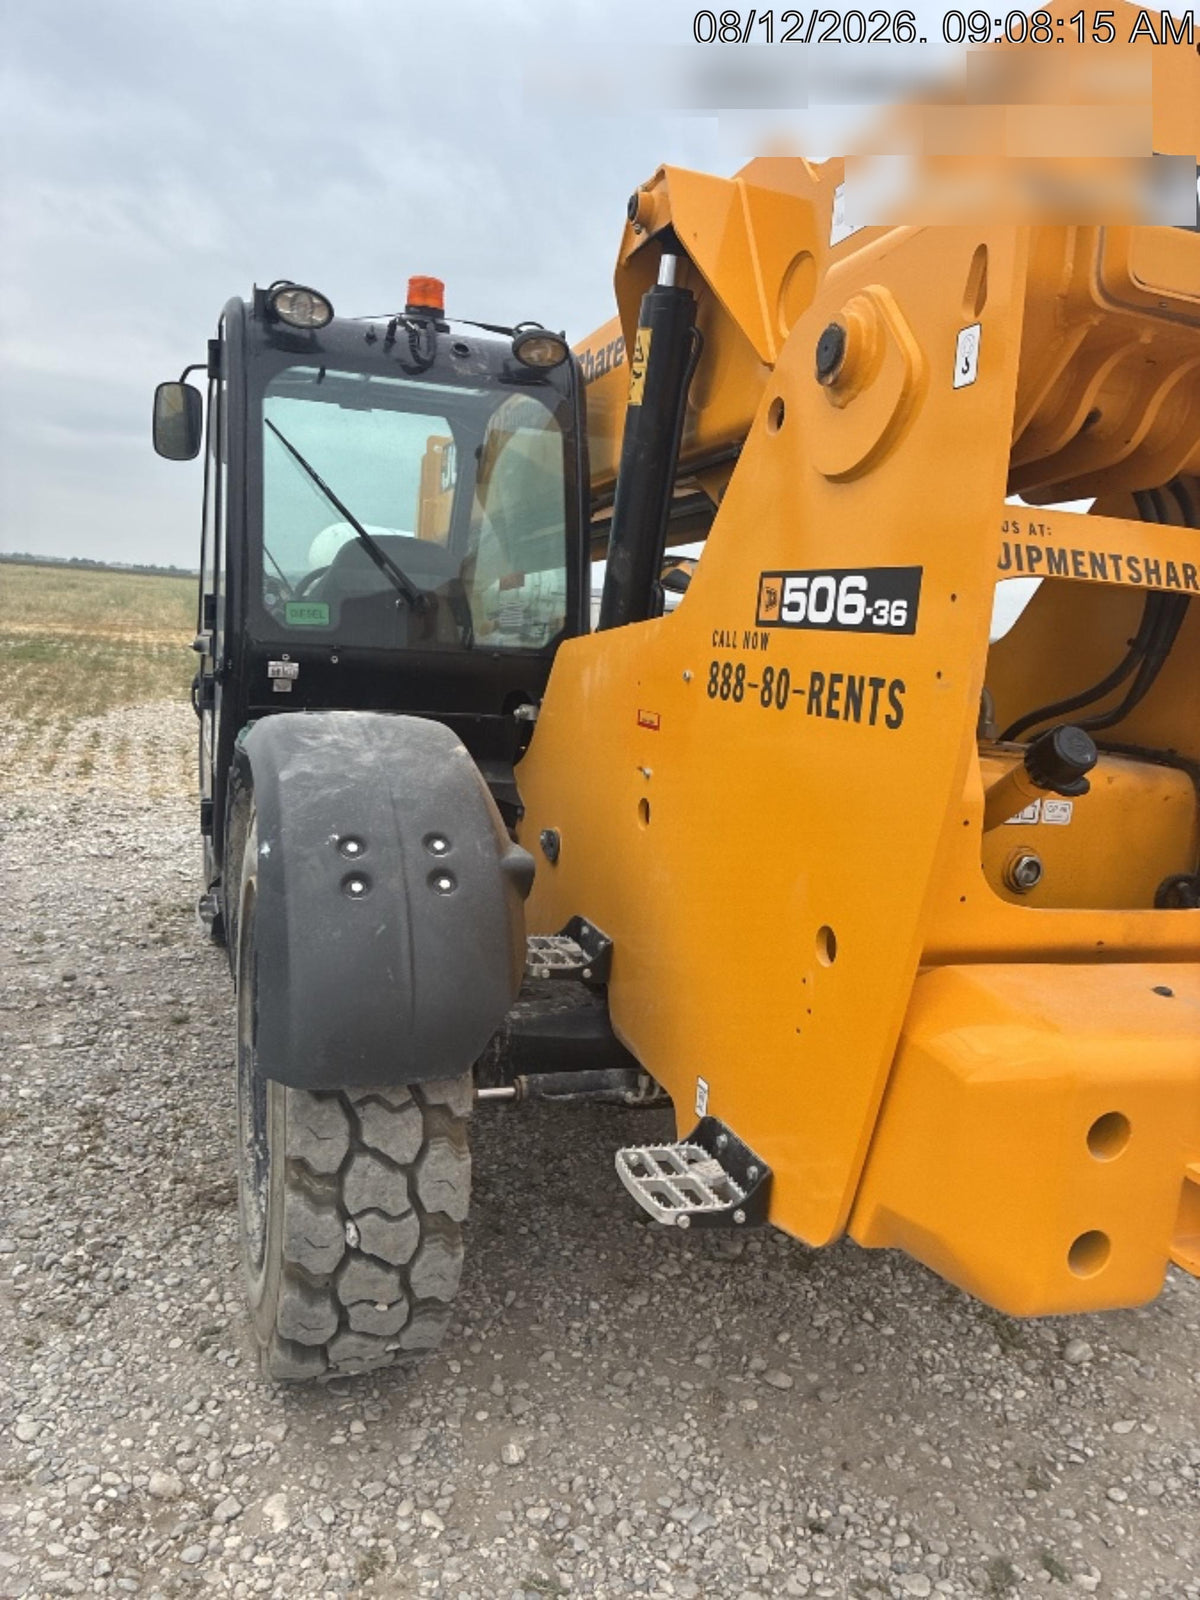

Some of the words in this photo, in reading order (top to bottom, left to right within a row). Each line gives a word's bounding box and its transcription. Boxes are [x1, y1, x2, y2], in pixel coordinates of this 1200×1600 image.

[1028, 522, 1053, 538] AT:
[712, 629, 738, 649] CALL
[742, 630, 771, 651] NOW
[707, 660, 907, 730] 888-80-RENTS
